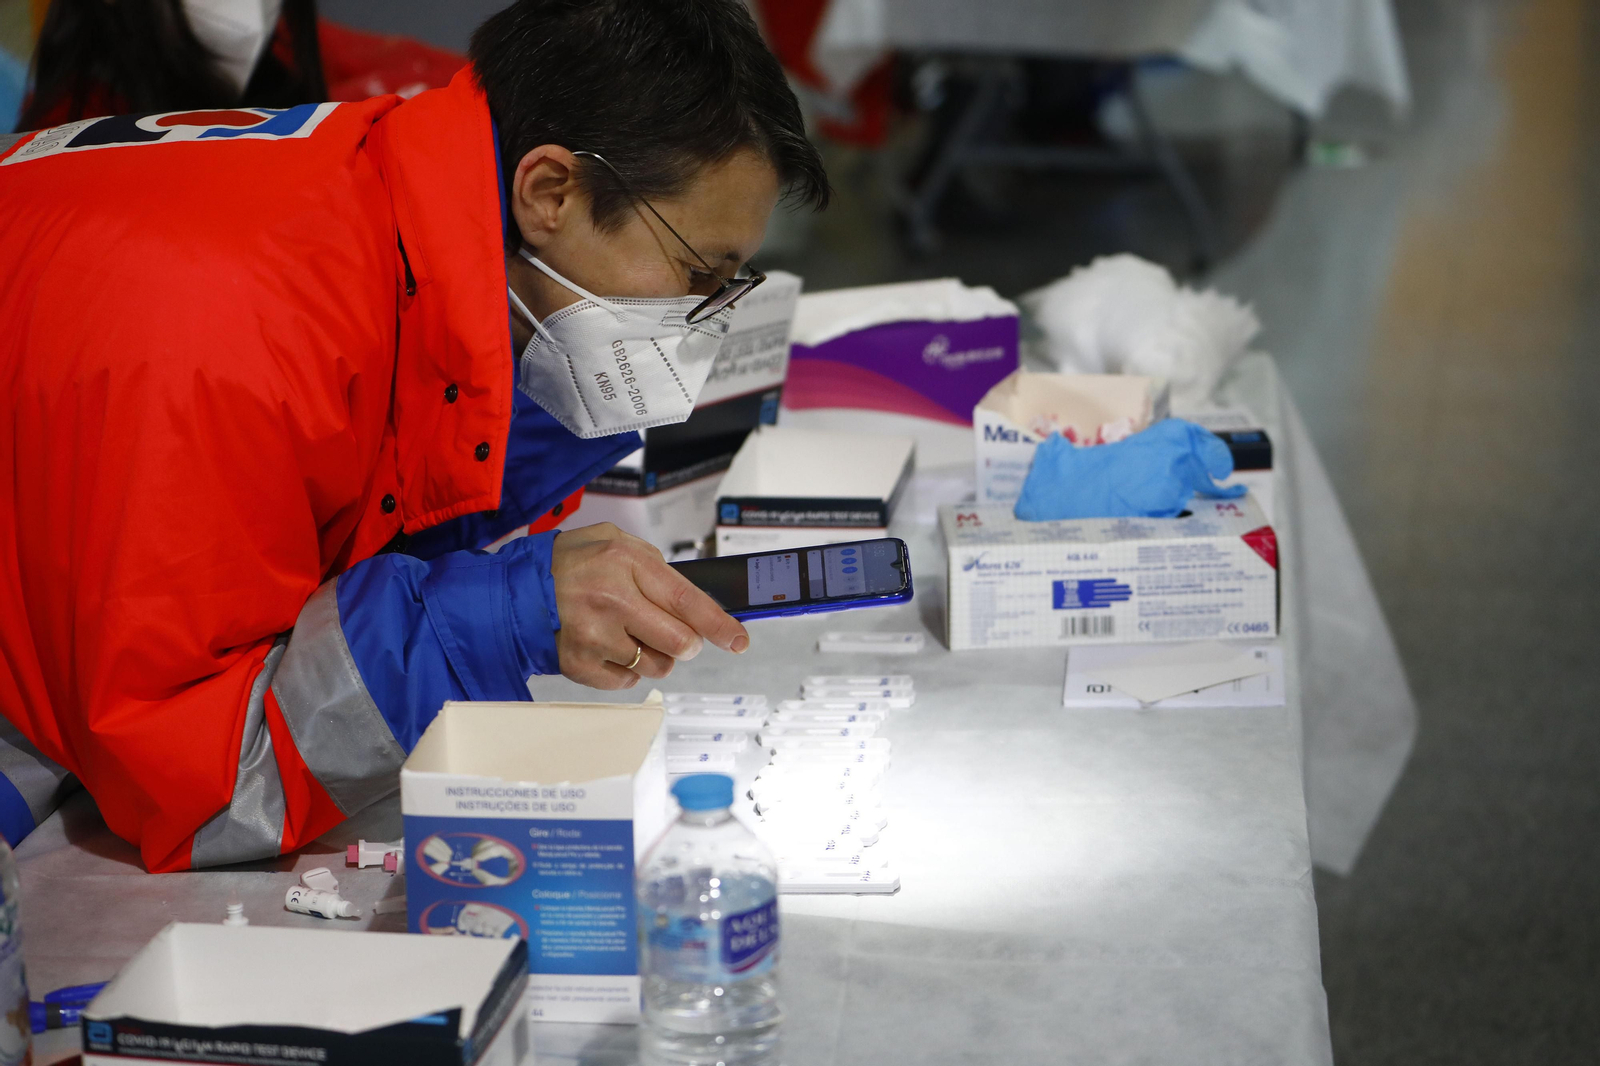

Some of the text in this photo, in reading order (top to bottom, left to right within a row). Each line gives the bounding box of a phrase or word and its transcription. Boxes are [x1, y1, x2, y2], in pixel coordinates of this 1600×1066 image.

[611, 339, 648, 416] GB2626-2006
[593, 371, 618, 401] KN95
[1242, 621, 1270, 634] 0465
[445, 786, 586, 799] INSTRUCCIONES DE USO
[455, 800, 576, 813] INSTRUÇÕES DE USO
[531, 888, 571, 900] Coloque
